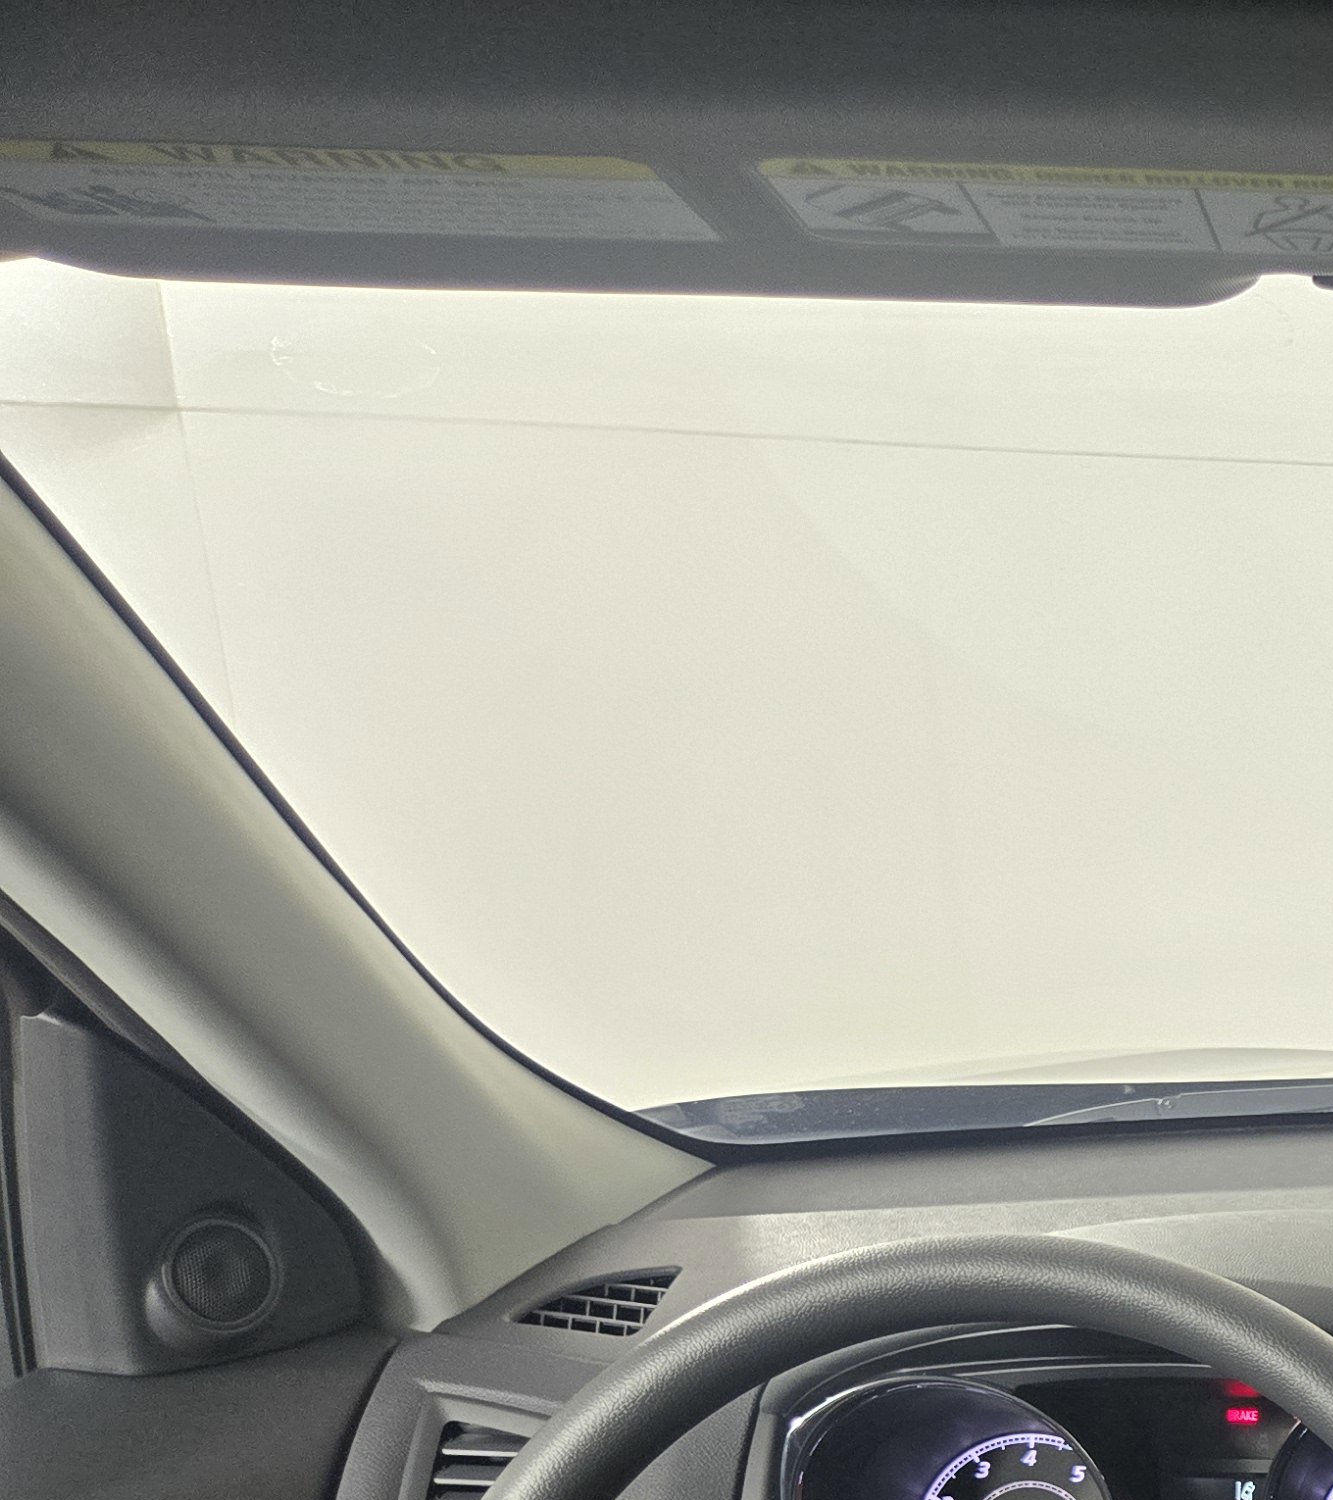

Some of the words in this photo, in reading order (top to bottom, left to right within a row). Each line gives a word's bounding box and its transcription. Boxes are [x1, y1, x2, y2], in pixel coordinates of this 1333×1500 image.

[147, 144, 510, 173] WARNING
[1021, 1450, 1037, 1466] 4
[975, 1462, 991, 1478] 3
[1069, 1465, 1086, 1482] 5
